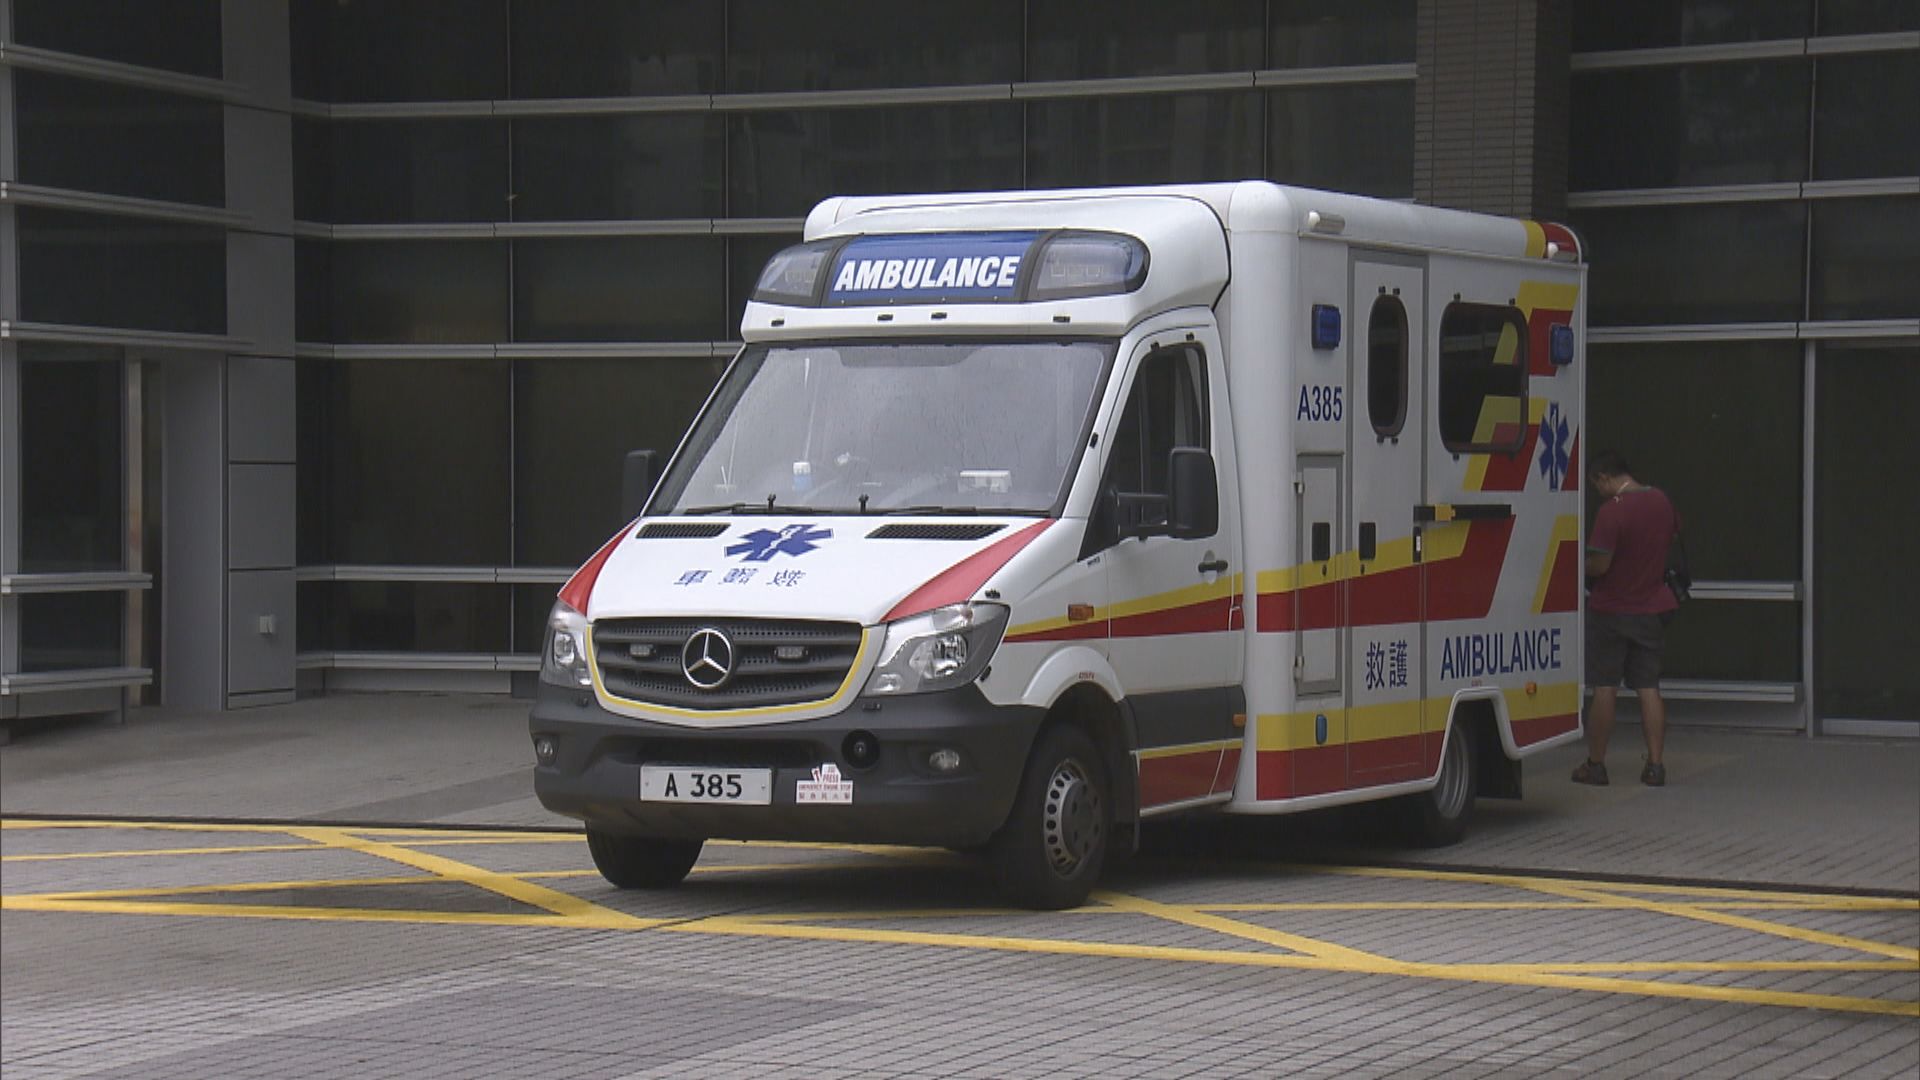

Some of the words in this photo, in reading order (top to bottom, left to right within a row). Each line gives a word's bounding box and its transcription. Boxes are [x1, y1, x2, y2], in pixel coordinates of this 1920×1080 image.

[833, 257, 1020, 291] AMBULANCE
[1297, 384, 1342, 421] A385
[1365, 639, 1408, 690] 救護
[1440, 628, 1561, 681] AMBULANCE
[664, 773, 679, 797] A
[690, 774, 743, 797] 385
